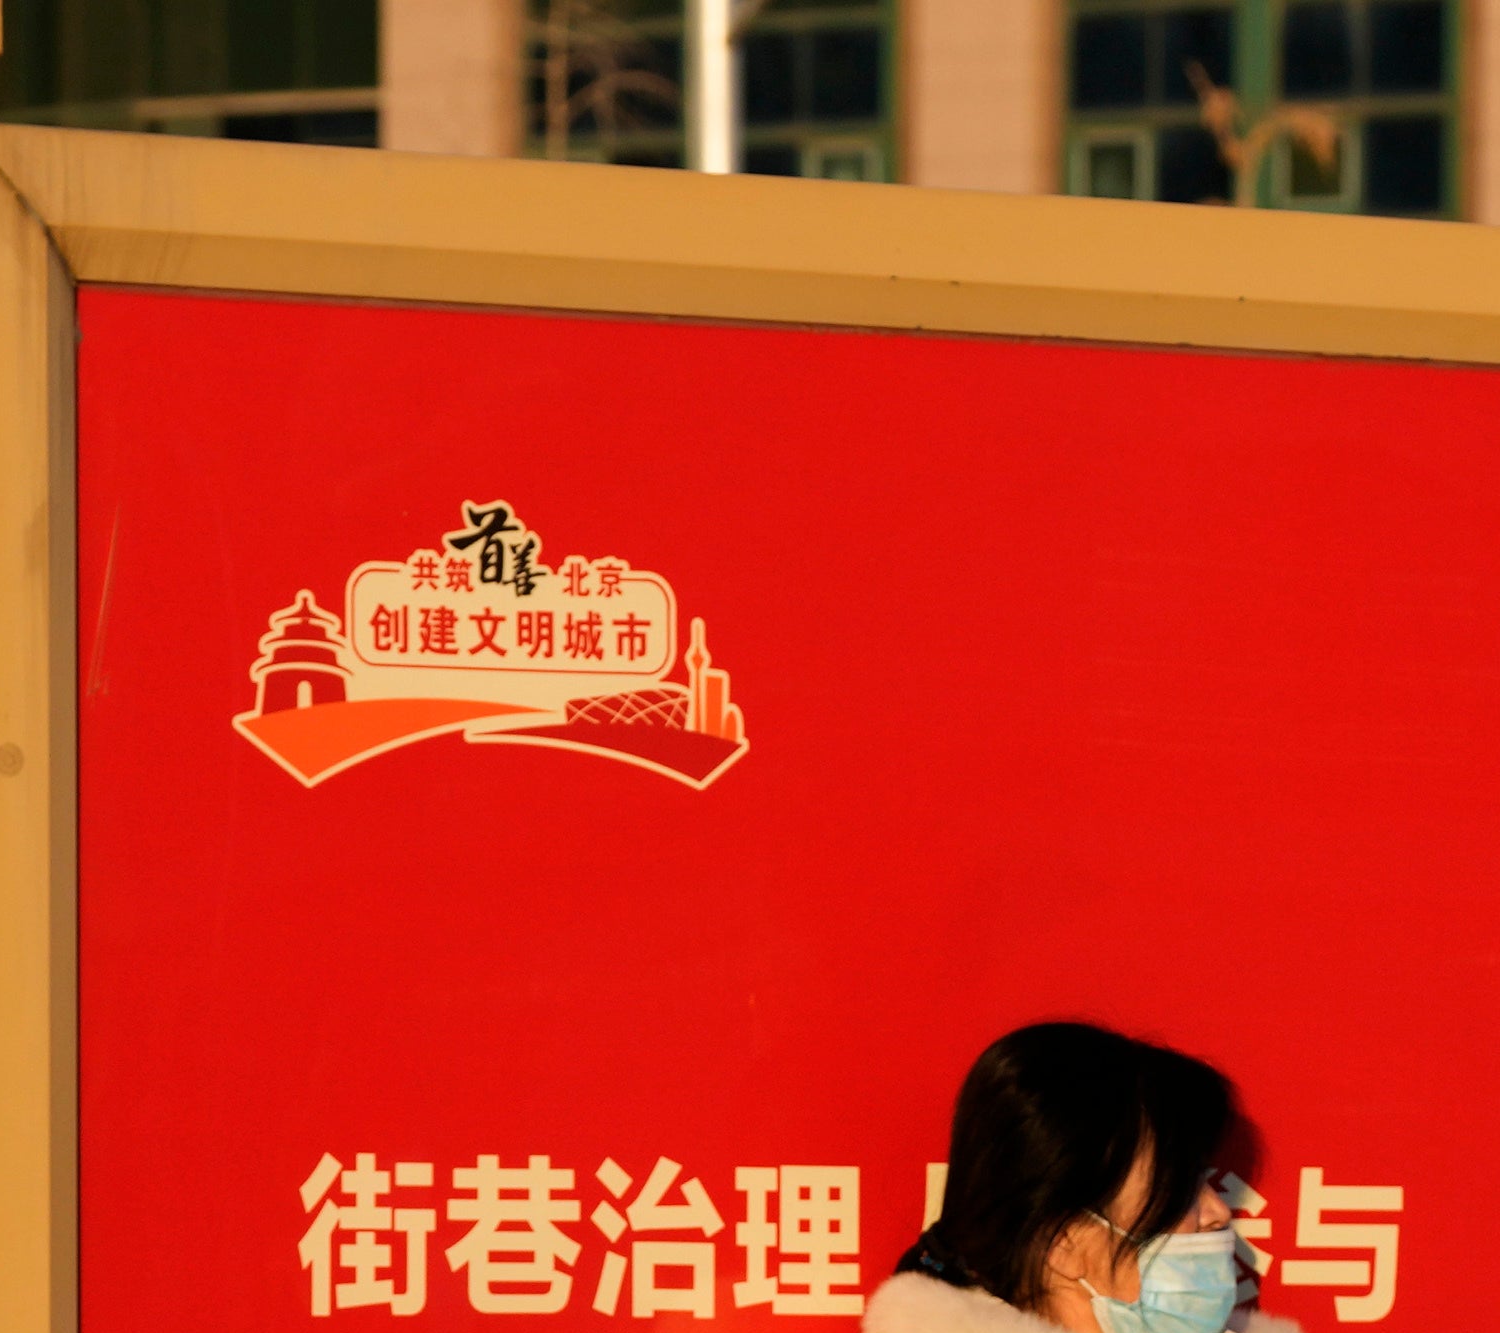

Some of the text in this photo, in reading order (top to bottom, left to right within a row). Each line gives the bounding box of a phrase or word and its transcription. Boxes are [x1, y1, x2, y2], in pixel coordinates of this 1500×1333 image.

[411, 556, 474, 592] 共筑
[563, 561, 624, 598] 北京
[369, 604, 652, 661] 创建文明城市
